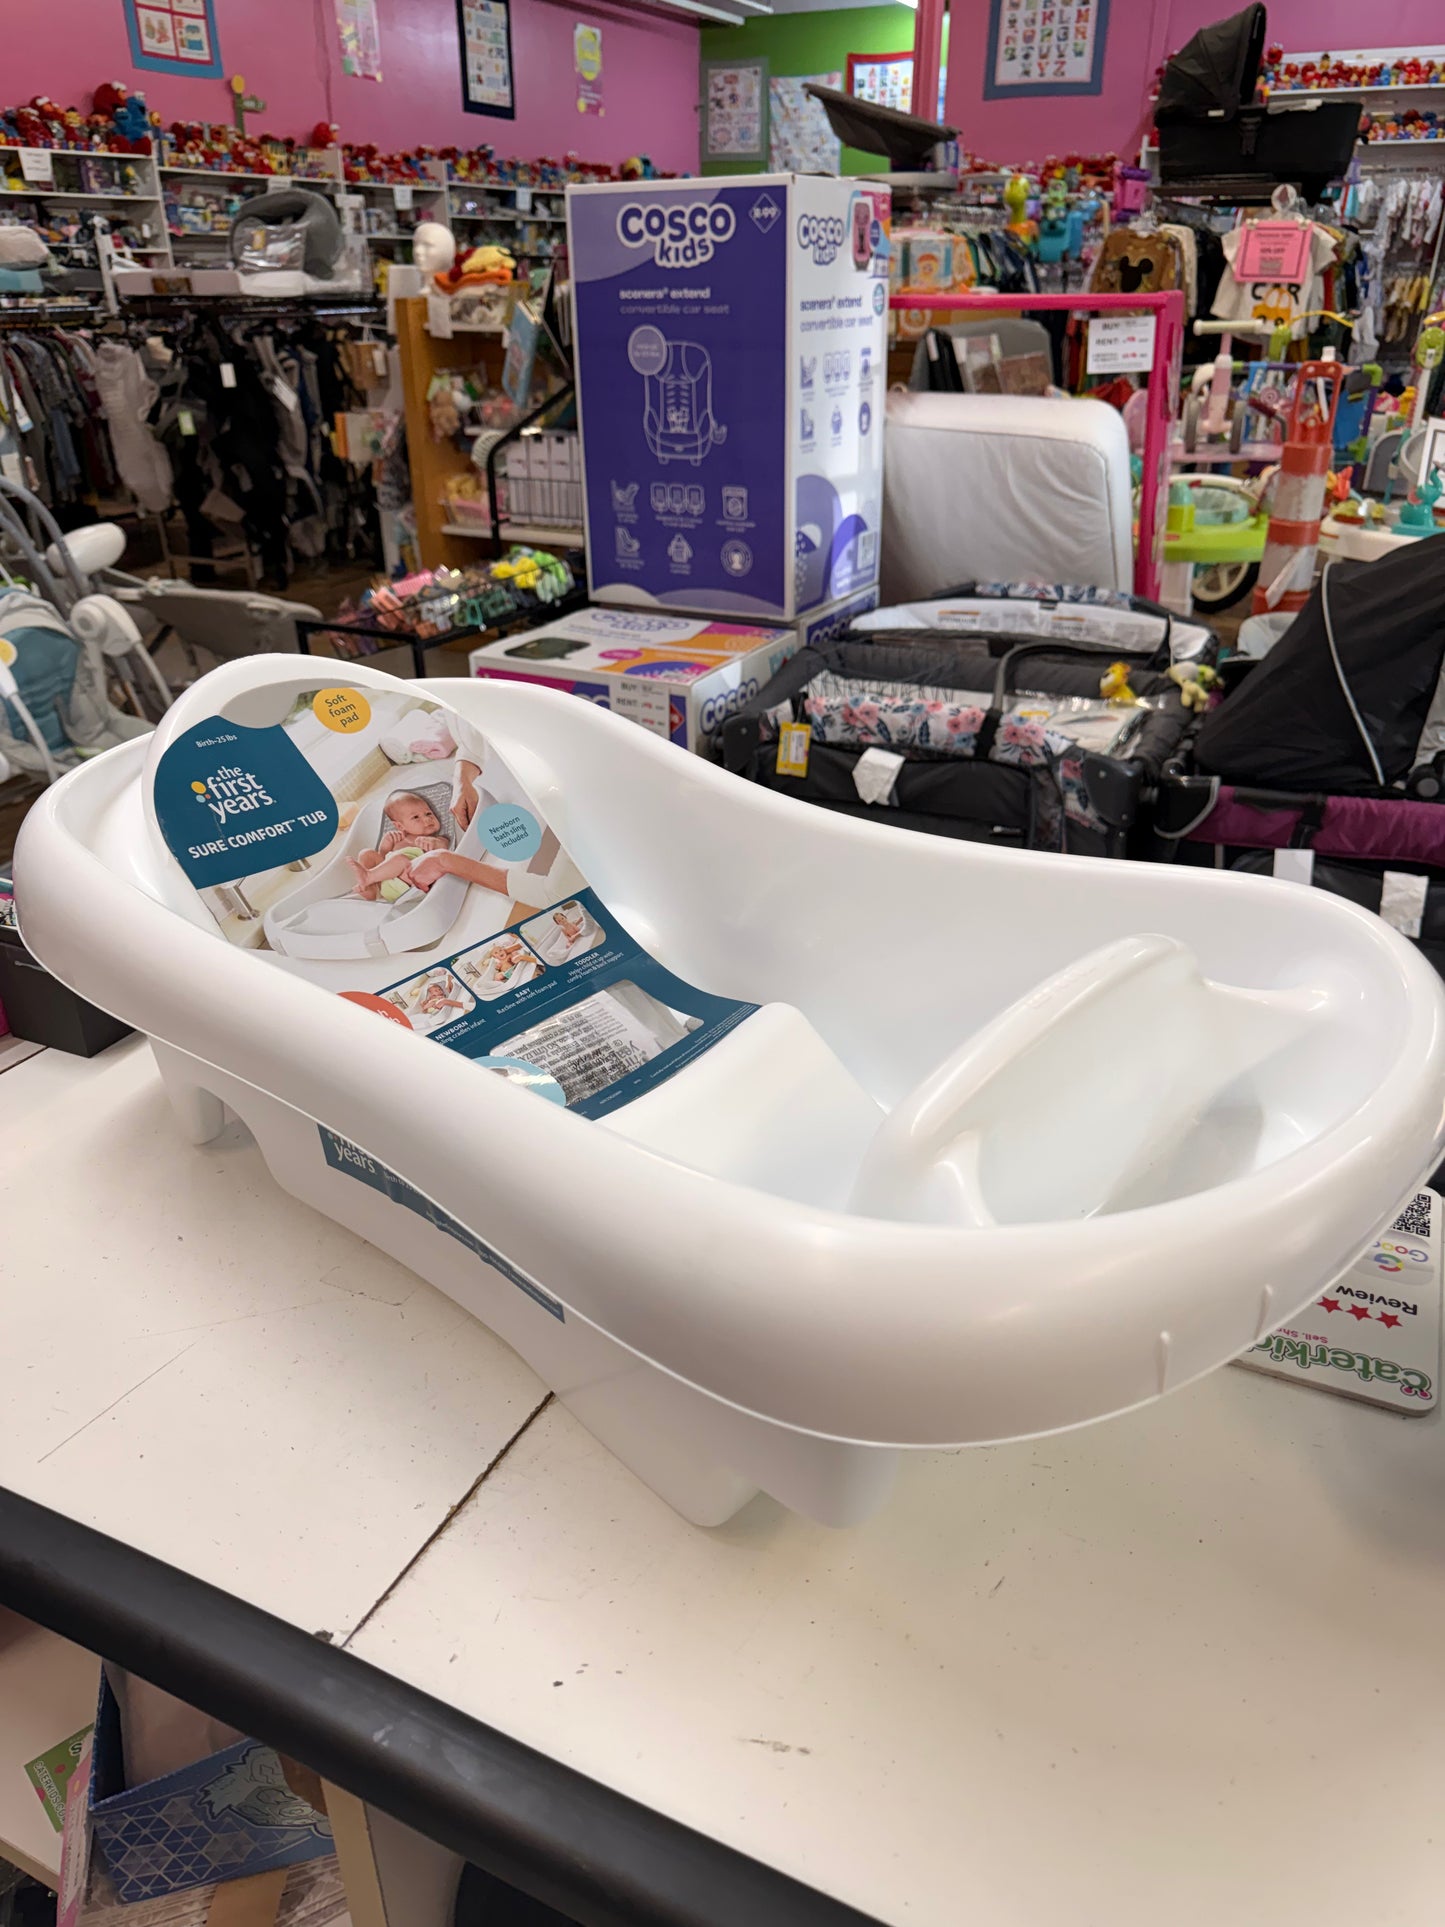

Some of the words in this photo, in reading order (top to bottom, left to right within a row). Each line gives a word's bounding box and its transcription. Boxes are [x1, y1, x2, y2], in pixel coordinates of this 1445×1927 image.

[656, 236, 713, 266] kids
[670, 286, 712, 300] extend
[1251, 281, 1302, 305] CR
[324, 693, 348, 708] Soft
[328, 702, 357, 719] foam
[339, 712, 360, 728] pad
[226, 733, 238, 742] lbs
[217, 765, 244, 781] the
[206, 771, 264, 800] first
[207, 788, 274, 825] years
[187, 838, 229, 860] SURE
[297, 809, 328, 828] TUB
[488, 816, 521, 836] Newborn
[493, 830, 511, 842] bath
[509, 823, 527, 836] sling
[500, 830, 529, 849] included
[573, 951, 600, 967] TODDLER
[514, 987, 531, 999] BABY
[434, 1020, 469, 1041] NEWBORN
[469, 1018, 487, 1030] infant
[333, 1141, 376, 1175] years
[1335, 1285, 1418, 1316] Review
[1302, 1332, 1329, 1344] Sell.
